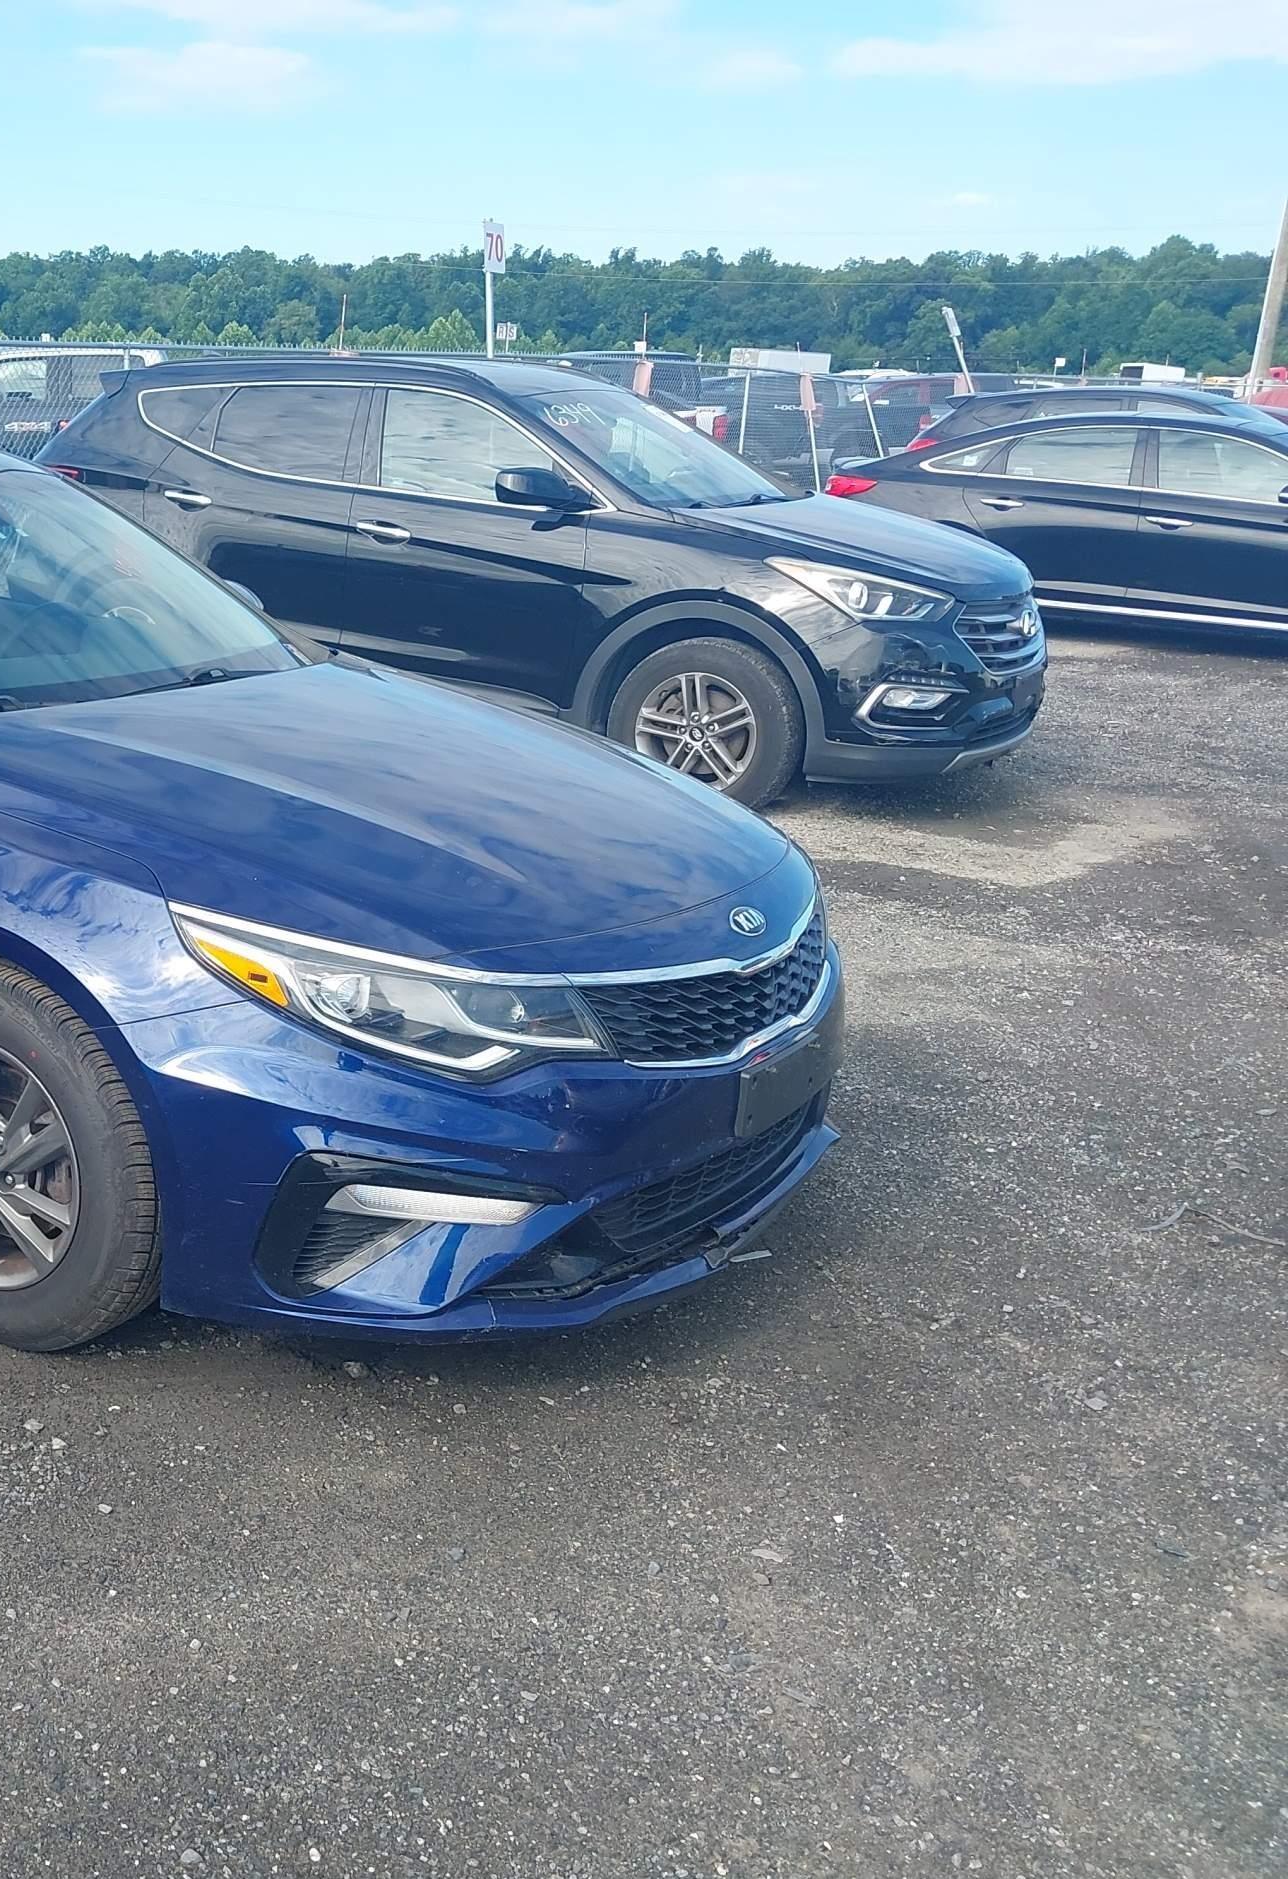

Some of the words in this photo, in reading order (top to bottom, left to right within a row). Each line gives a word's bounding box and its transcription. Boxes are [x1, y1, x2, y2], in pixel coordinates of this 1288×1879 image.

[486, 232, 503, 263] 70
[498, 327, 505, 337] R
[508, 327, 515, 337] S
[544, 402, 606, 427] 6349
[734, 909, 764, 931] KIA
